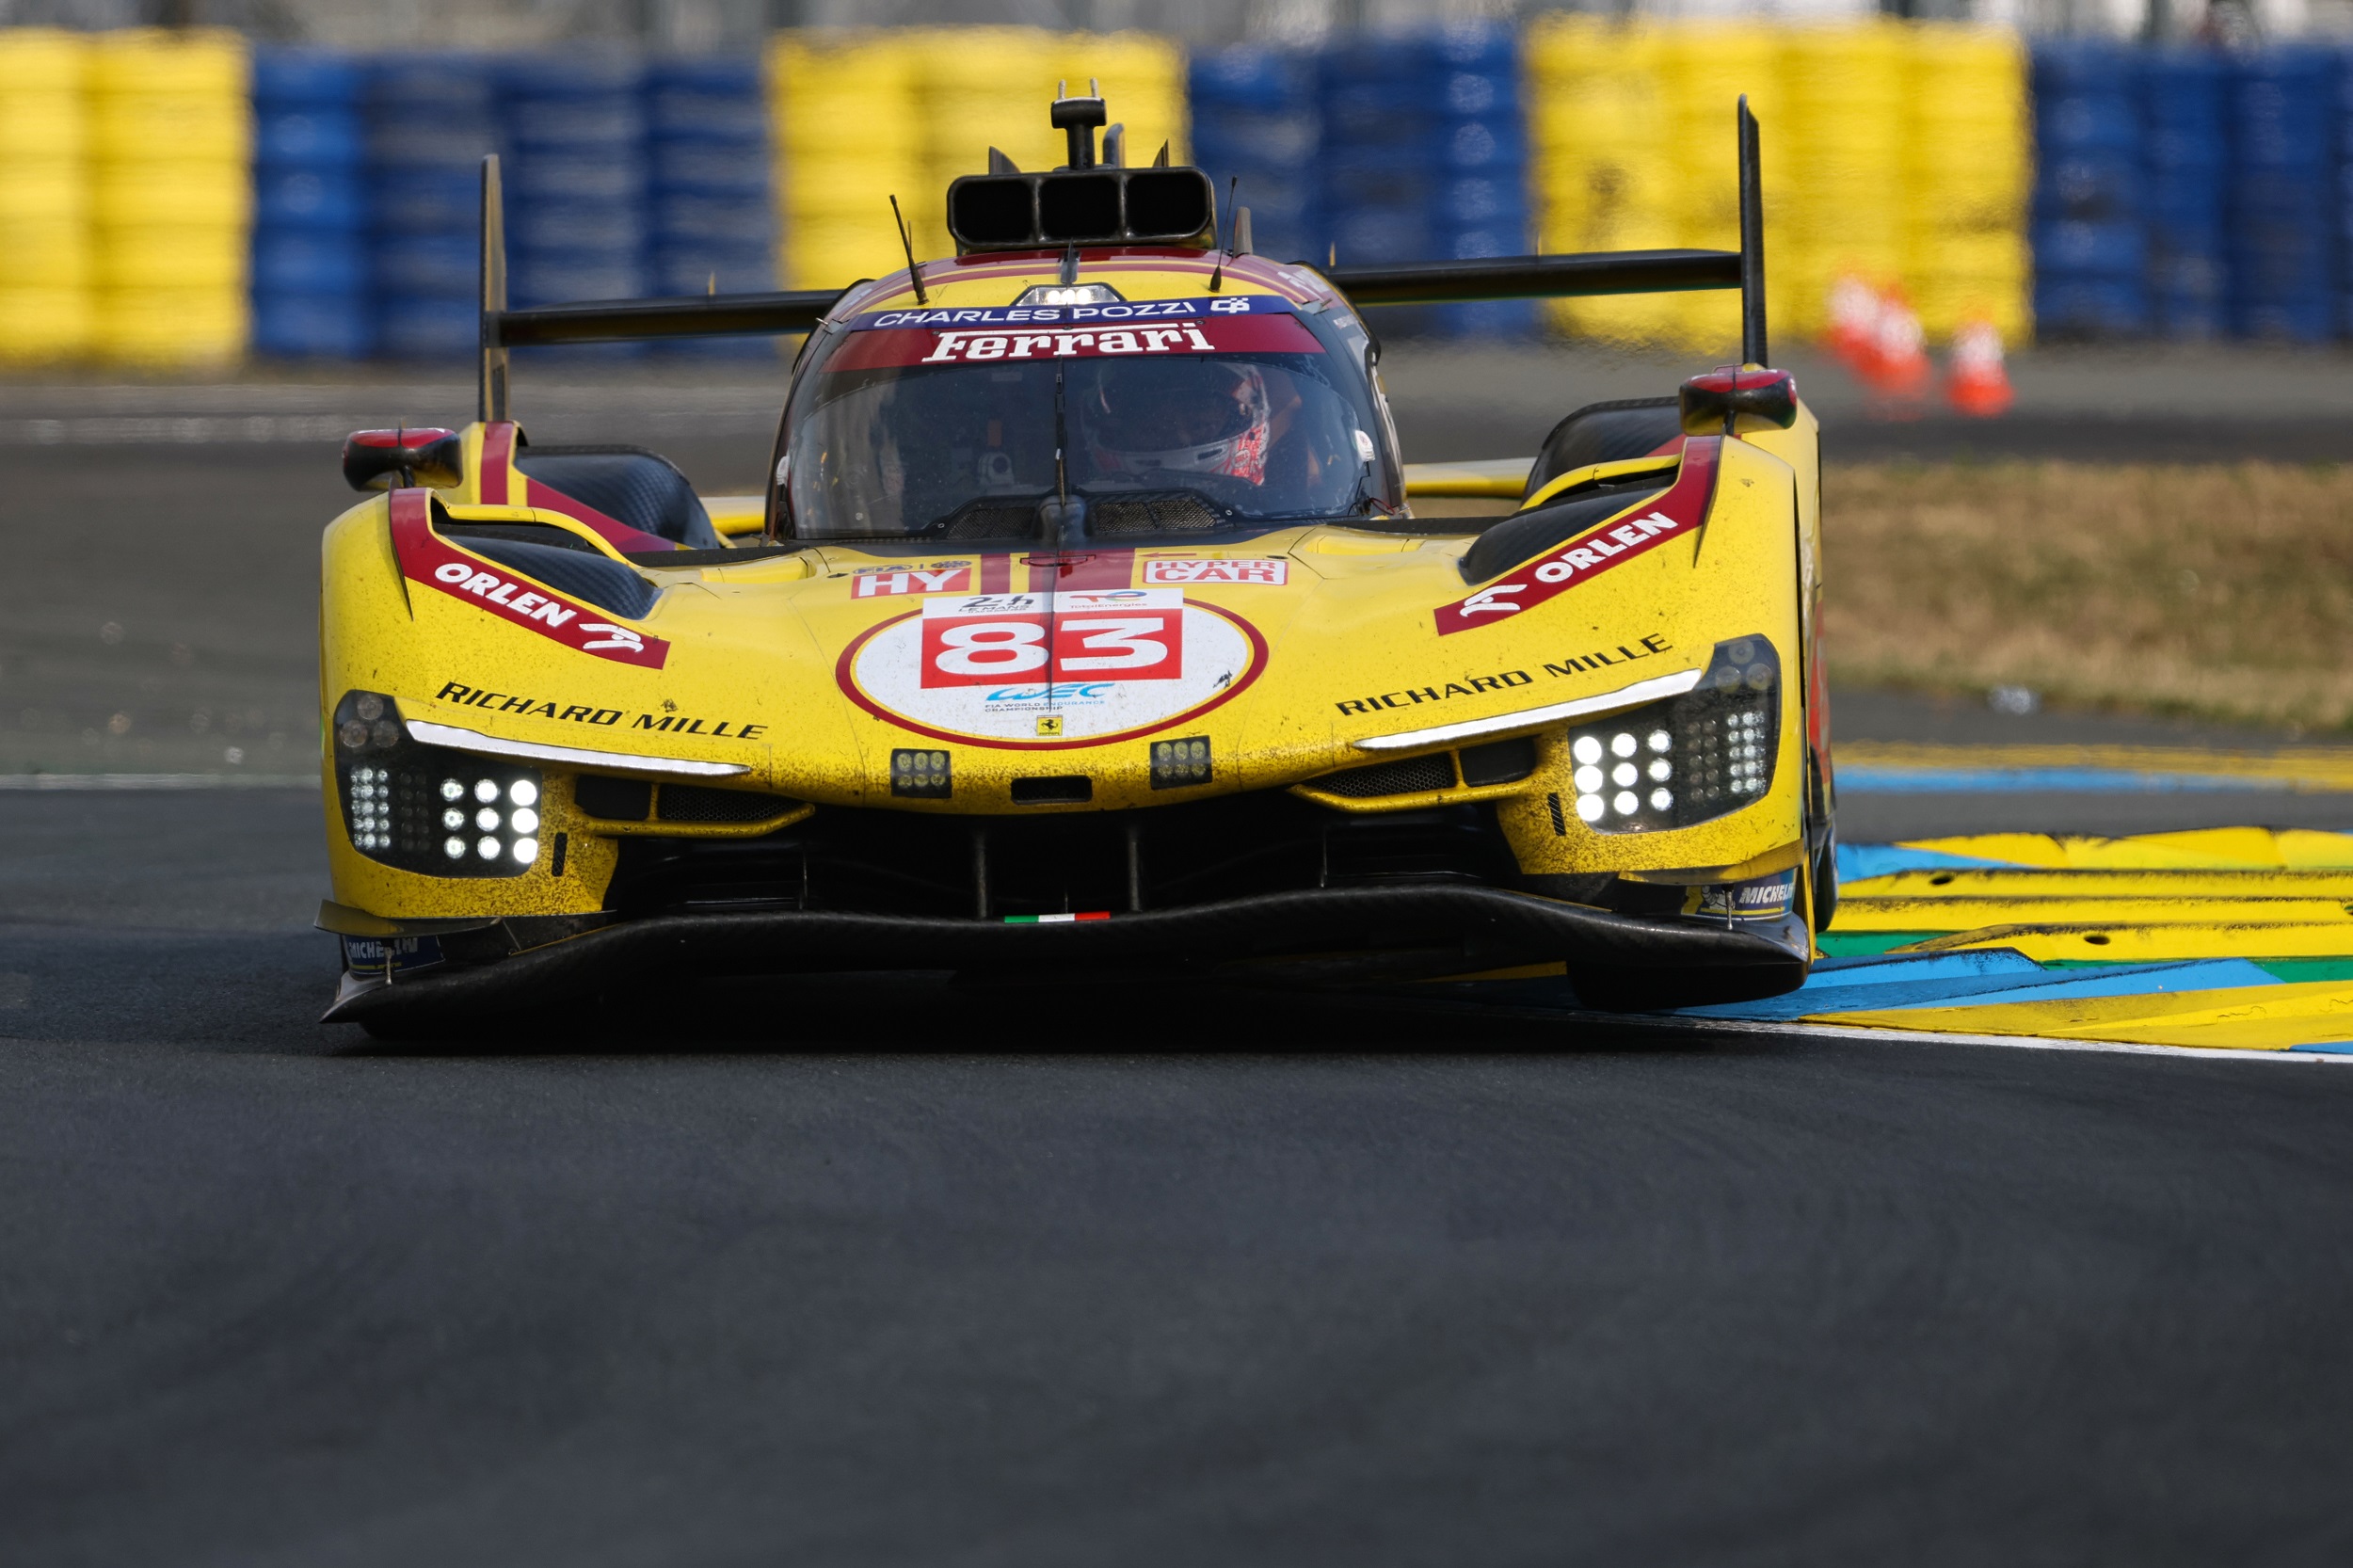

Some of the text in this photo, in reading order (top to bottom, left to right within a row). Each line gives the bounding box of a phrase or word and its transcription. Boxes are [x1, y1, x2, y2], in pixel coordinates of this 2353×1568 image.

[873, 301, 1195, 327] CHARLES POZZI
[921, 323, 1215, 362] Ferrari
[1535, 511, 1678, 583] ORLEN
[435, 563, 577, 628] ORLEN
[857, 569, 964, 597] HY
[1155, 568, 1275, 582] CAR
[936, 616, 1168, 675] 83
[985, 683, 1115, 701] WEC
[1336, 632, 1673, 716] RICHARD MILLE
[435, 681, 768, 740] RICHARD MILLE
